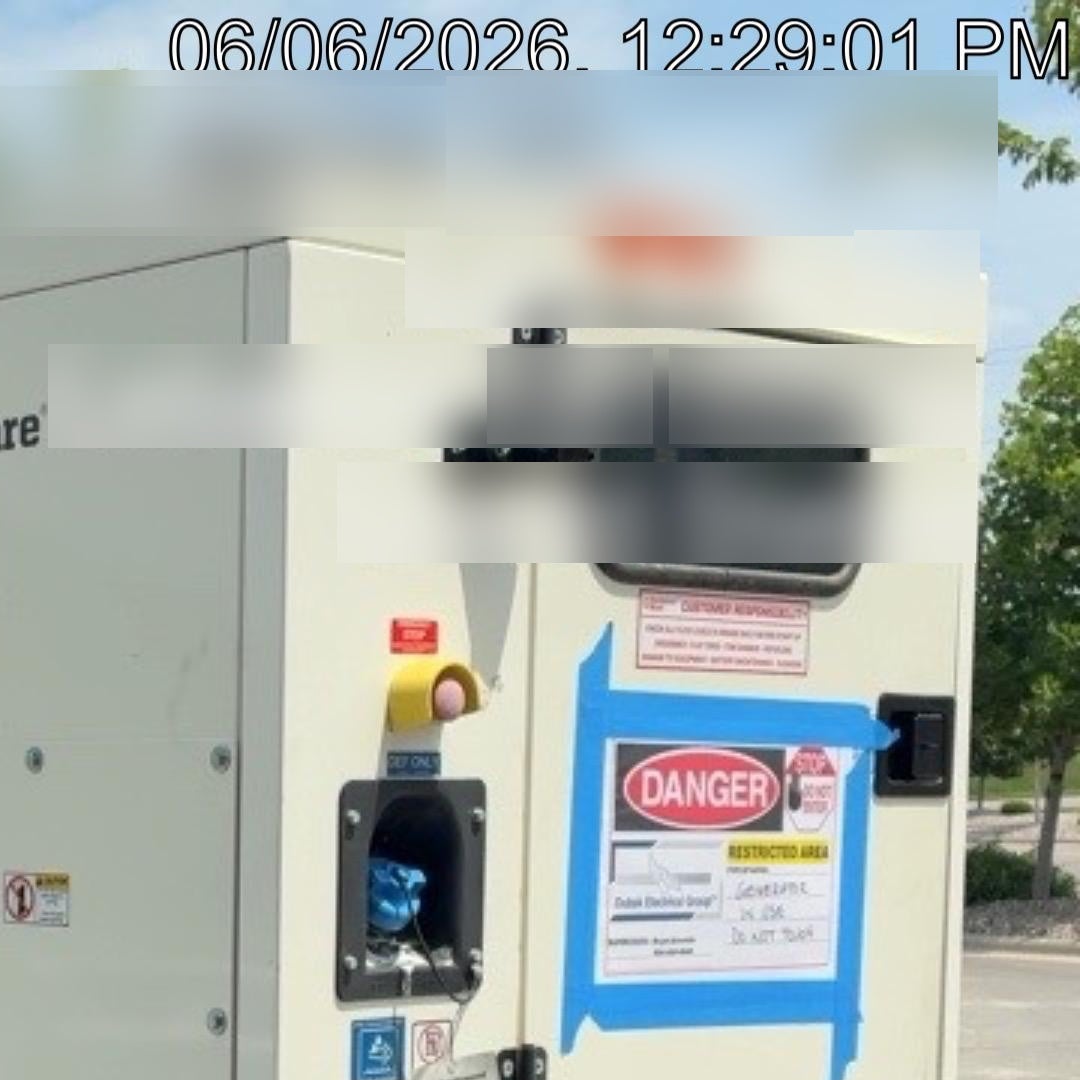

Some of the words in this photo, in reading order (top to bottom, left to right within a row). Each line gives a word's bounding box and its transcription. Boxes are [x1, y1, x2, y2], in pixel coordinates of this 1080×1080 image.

[794, 753, 826, 771] STOP
[640, 769, 769, 809] DANGER
[727, 845, 798, 859] RESTRICTED
[800, 845, 829, 859] AREA
